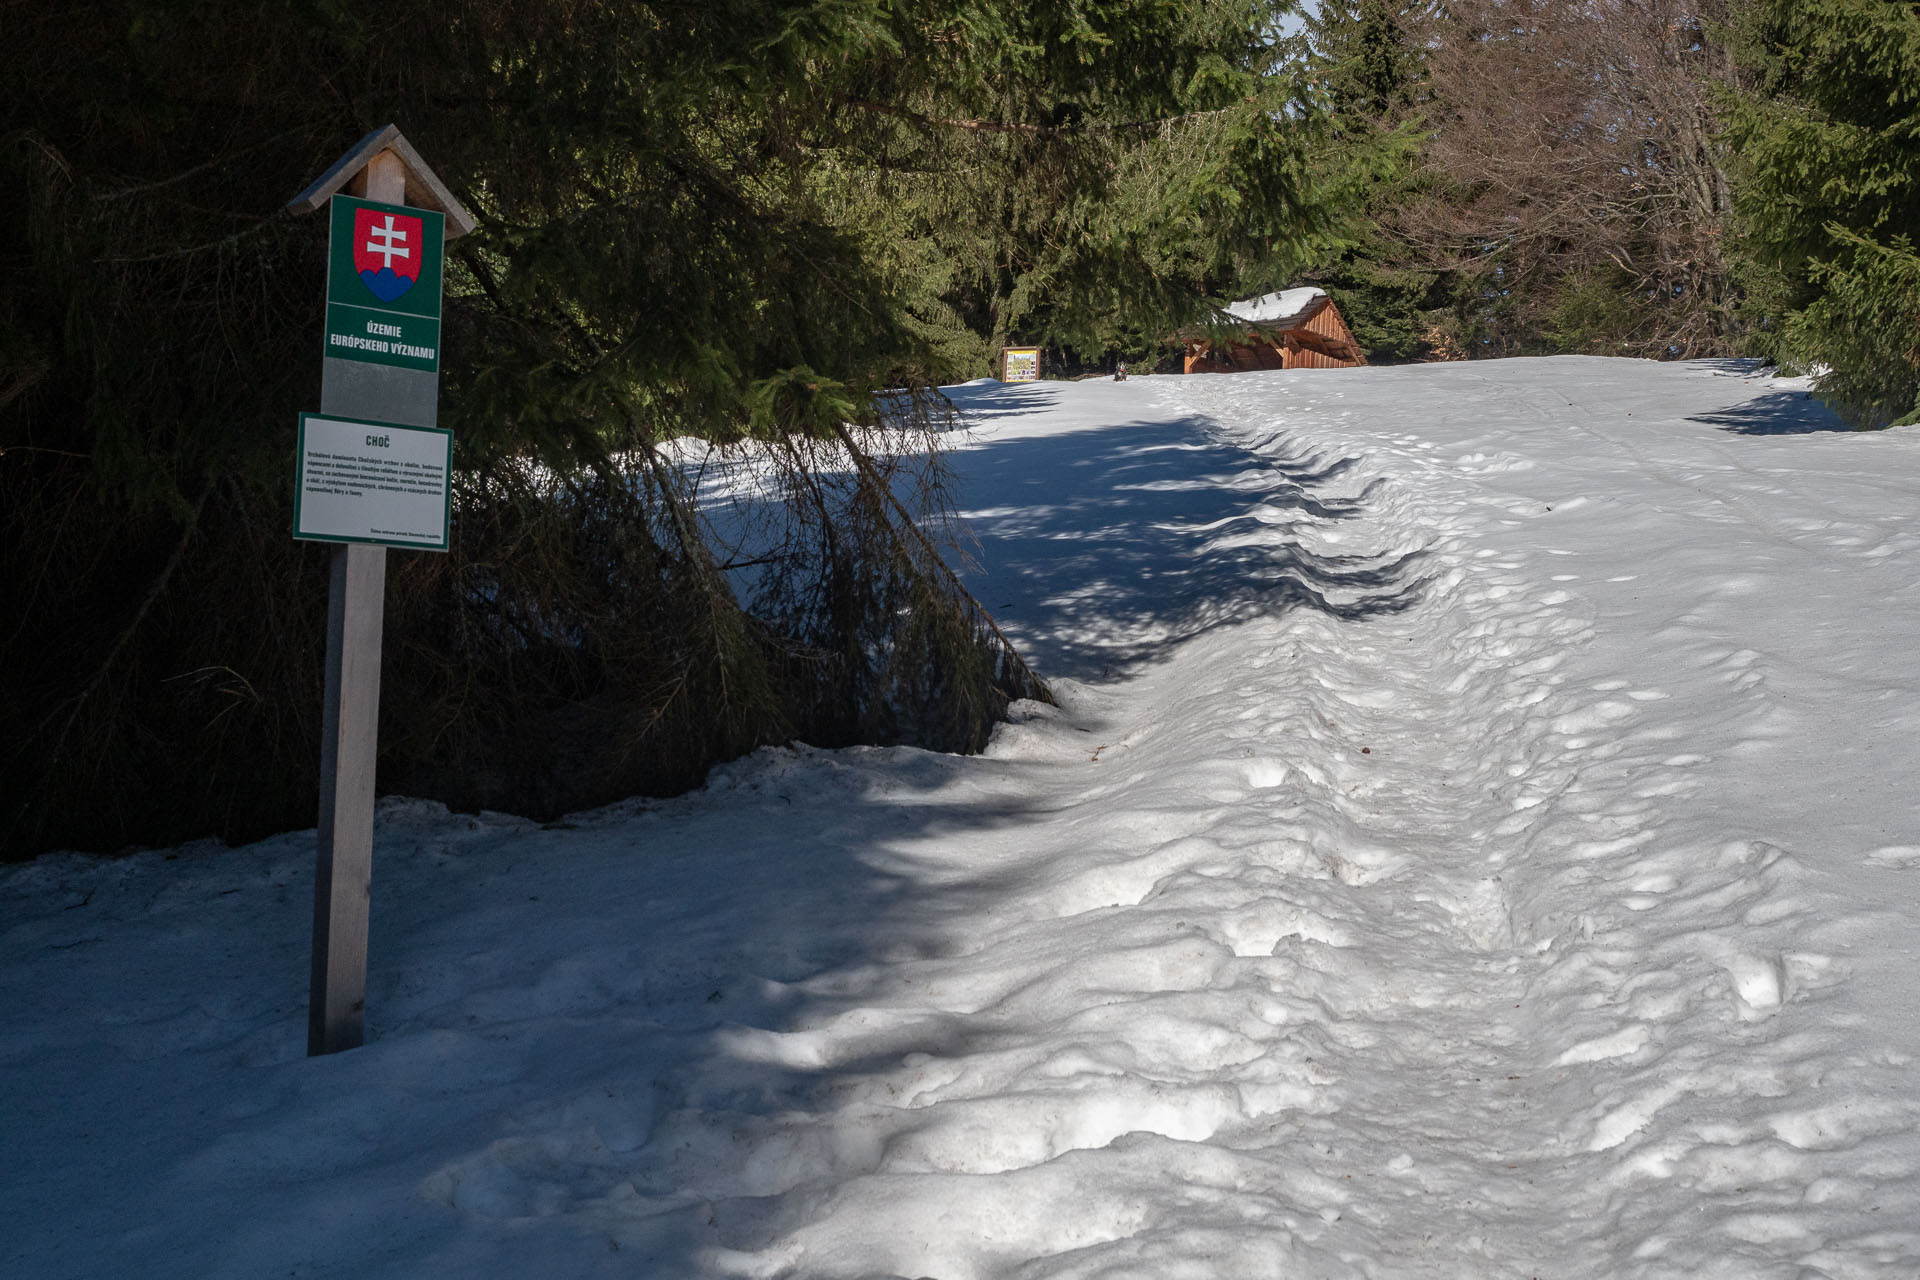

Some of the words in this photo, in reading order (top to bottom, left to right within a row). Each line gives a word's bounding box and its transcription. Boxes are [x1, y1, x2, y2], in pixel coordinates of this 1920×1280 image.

[367, 320, 402, 338] ÚZEMIE
[330, 334, 389, 353] EURÓPSKEHO
[391, 342, 435, 360] VÝZNAMU
[366, 435, 390, 448] CHOČ
